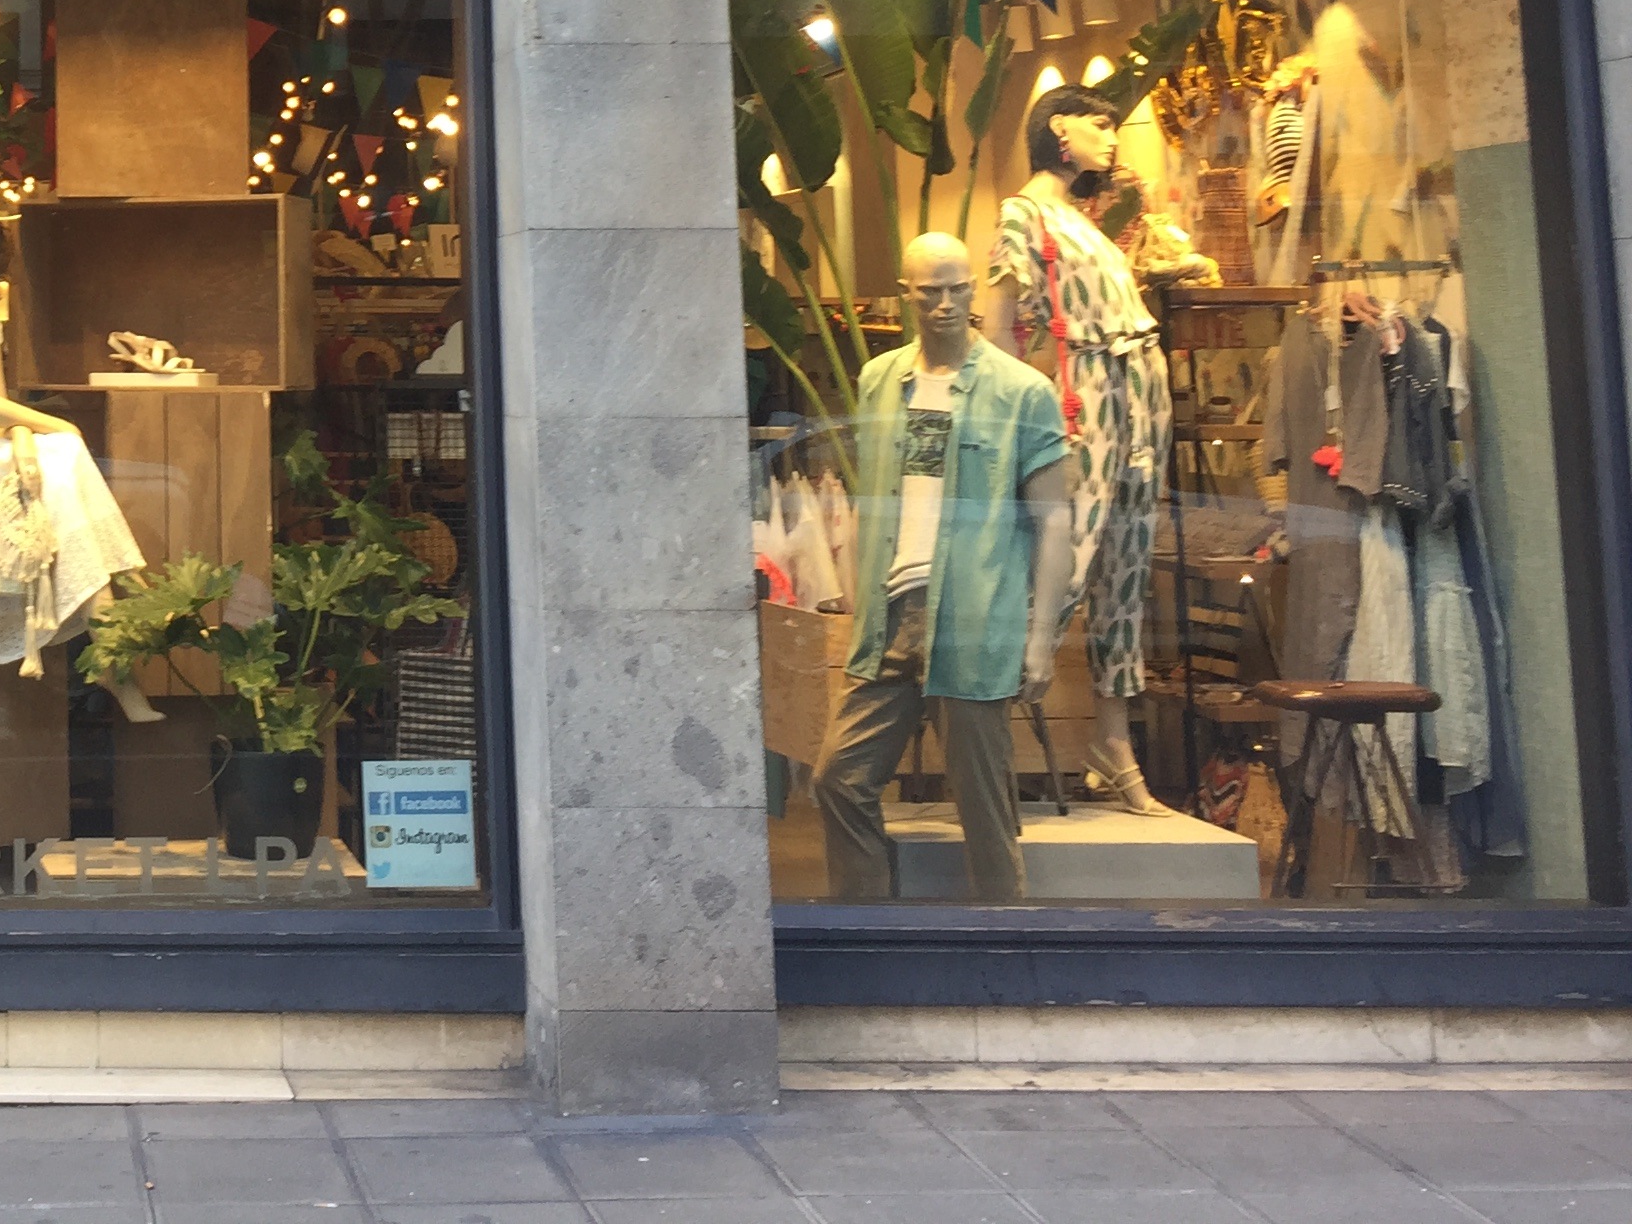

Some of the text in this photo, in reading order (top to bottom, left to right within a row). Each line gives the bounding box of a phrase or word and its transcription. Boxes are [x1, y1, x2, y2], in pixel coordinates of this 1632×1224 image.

[400, 796, 462, 811] facebook
[395, 828, 469, 854] Instagram
[206, 836, 352, 897] LPA
